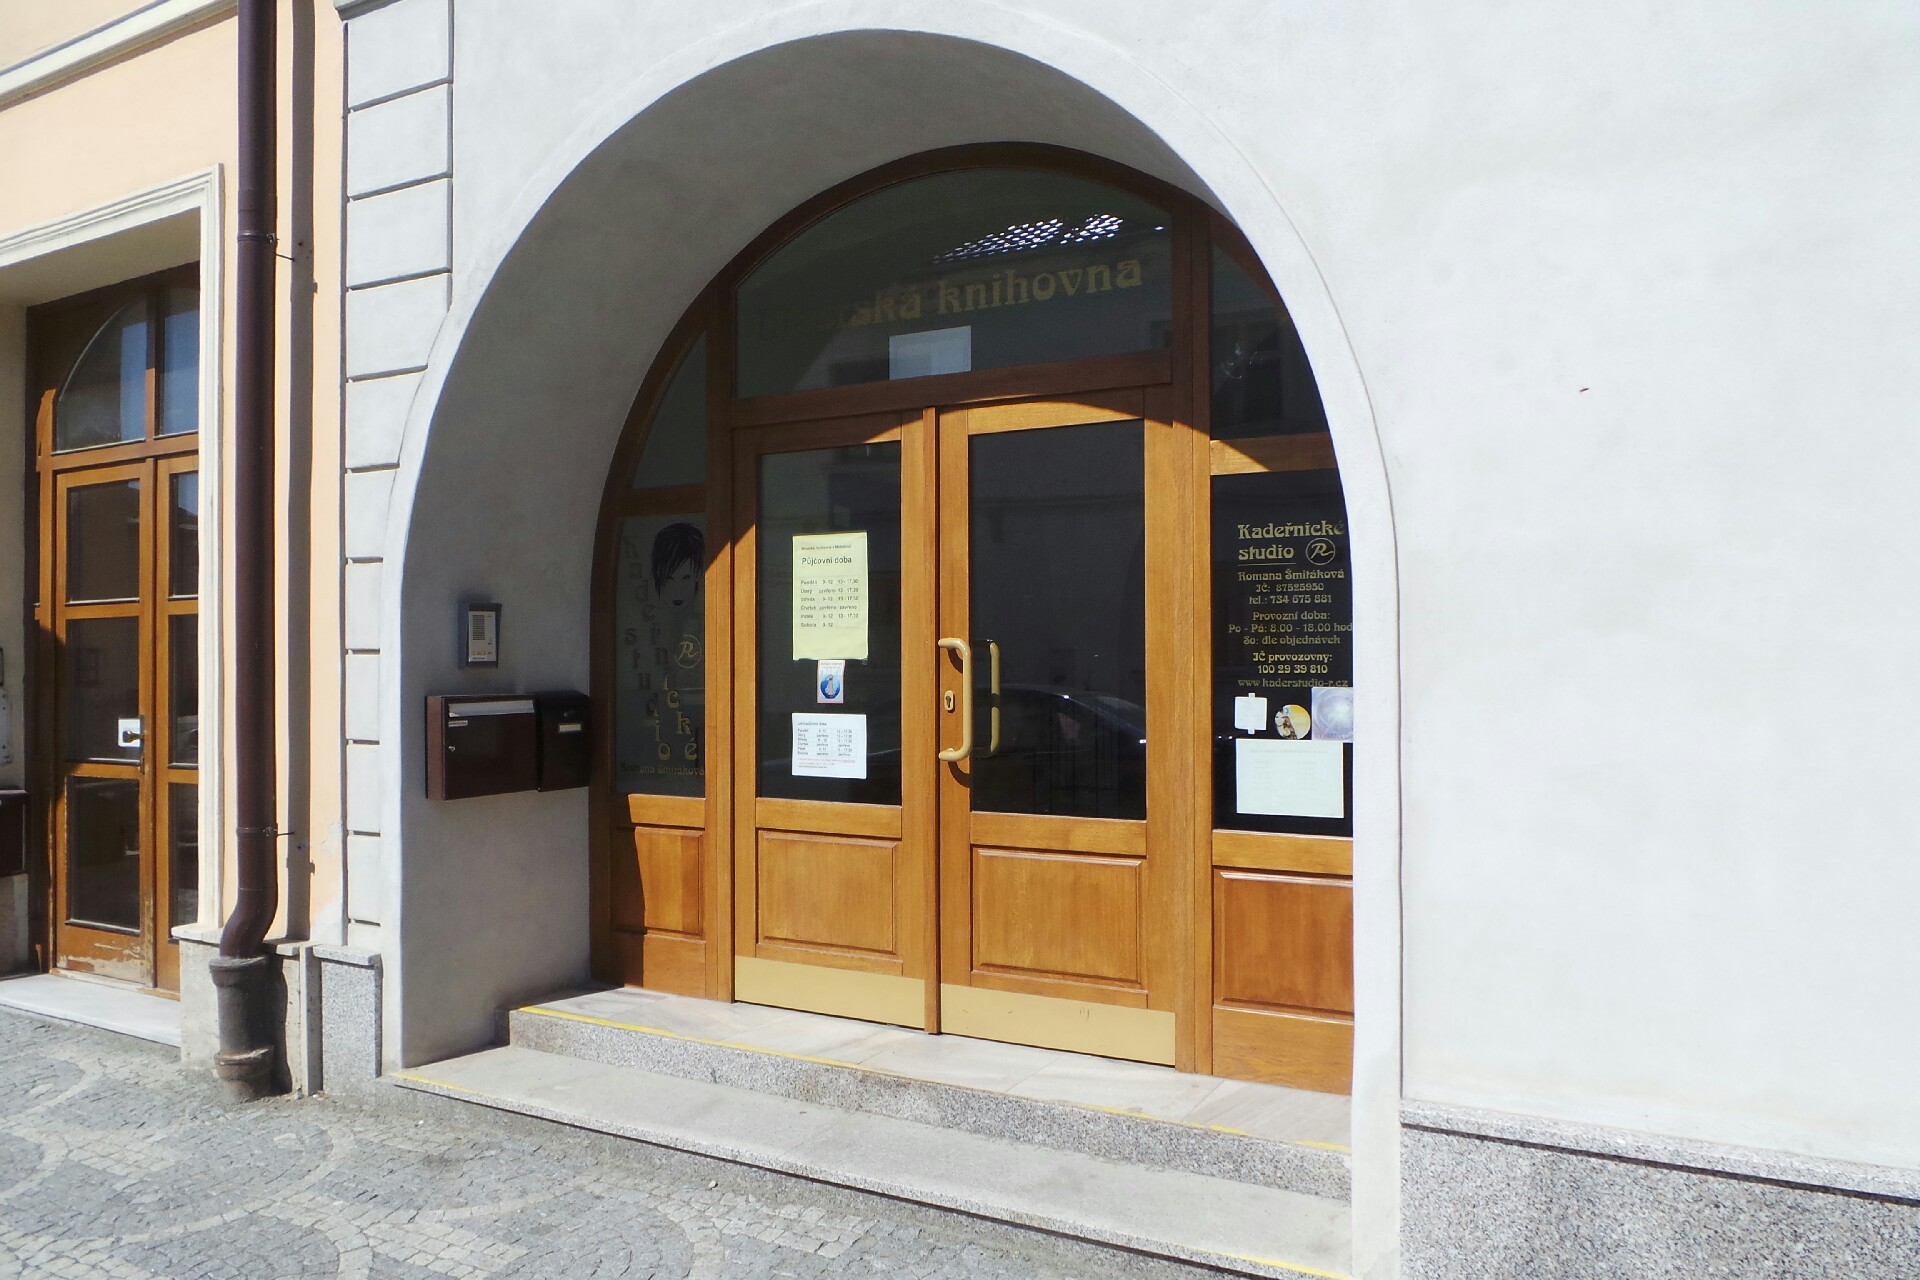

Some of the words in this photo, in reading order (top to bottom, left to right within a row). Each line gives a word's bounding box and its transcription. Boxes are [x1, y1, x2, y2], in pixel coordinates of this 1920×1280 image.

[937, 258, 1143, 316] knihovna
[1237, 520, 1345, 540] Kadeřnické
[1238, 544, 1296, 561] studio
[834, 555, 852, 564] doba
[1238, 571, 1282, 581] Romana
[1285, 568, 1345, 580] Šmitáková
[1270, 595, 1290, 604] 734
[1314, 594, 1333, 603] 881
[1253, 611, 1298, 620] Provozní
[1301, 610, 1330, 620] doba:
[1228, 624, 1241, 633] Po
[1251, 623, 1267, 633] Pá:
[1269, 623, 1293, 632] 8.00
[1303, 623, 1331, 632] 18.00
[1243, 636, 1259, 645] So:
[1261, 636, 1278, 645] dle
[1280, 635, 1341, 646] objednávek
[1268, 653, 1333, 663] provozovny:
[1257, 664, 1275, 674] 100
[1277, 664, 1291, 674] 29
[1294, 664, 1307, 674] 39
[1310, 664, 1329, 674] 810
